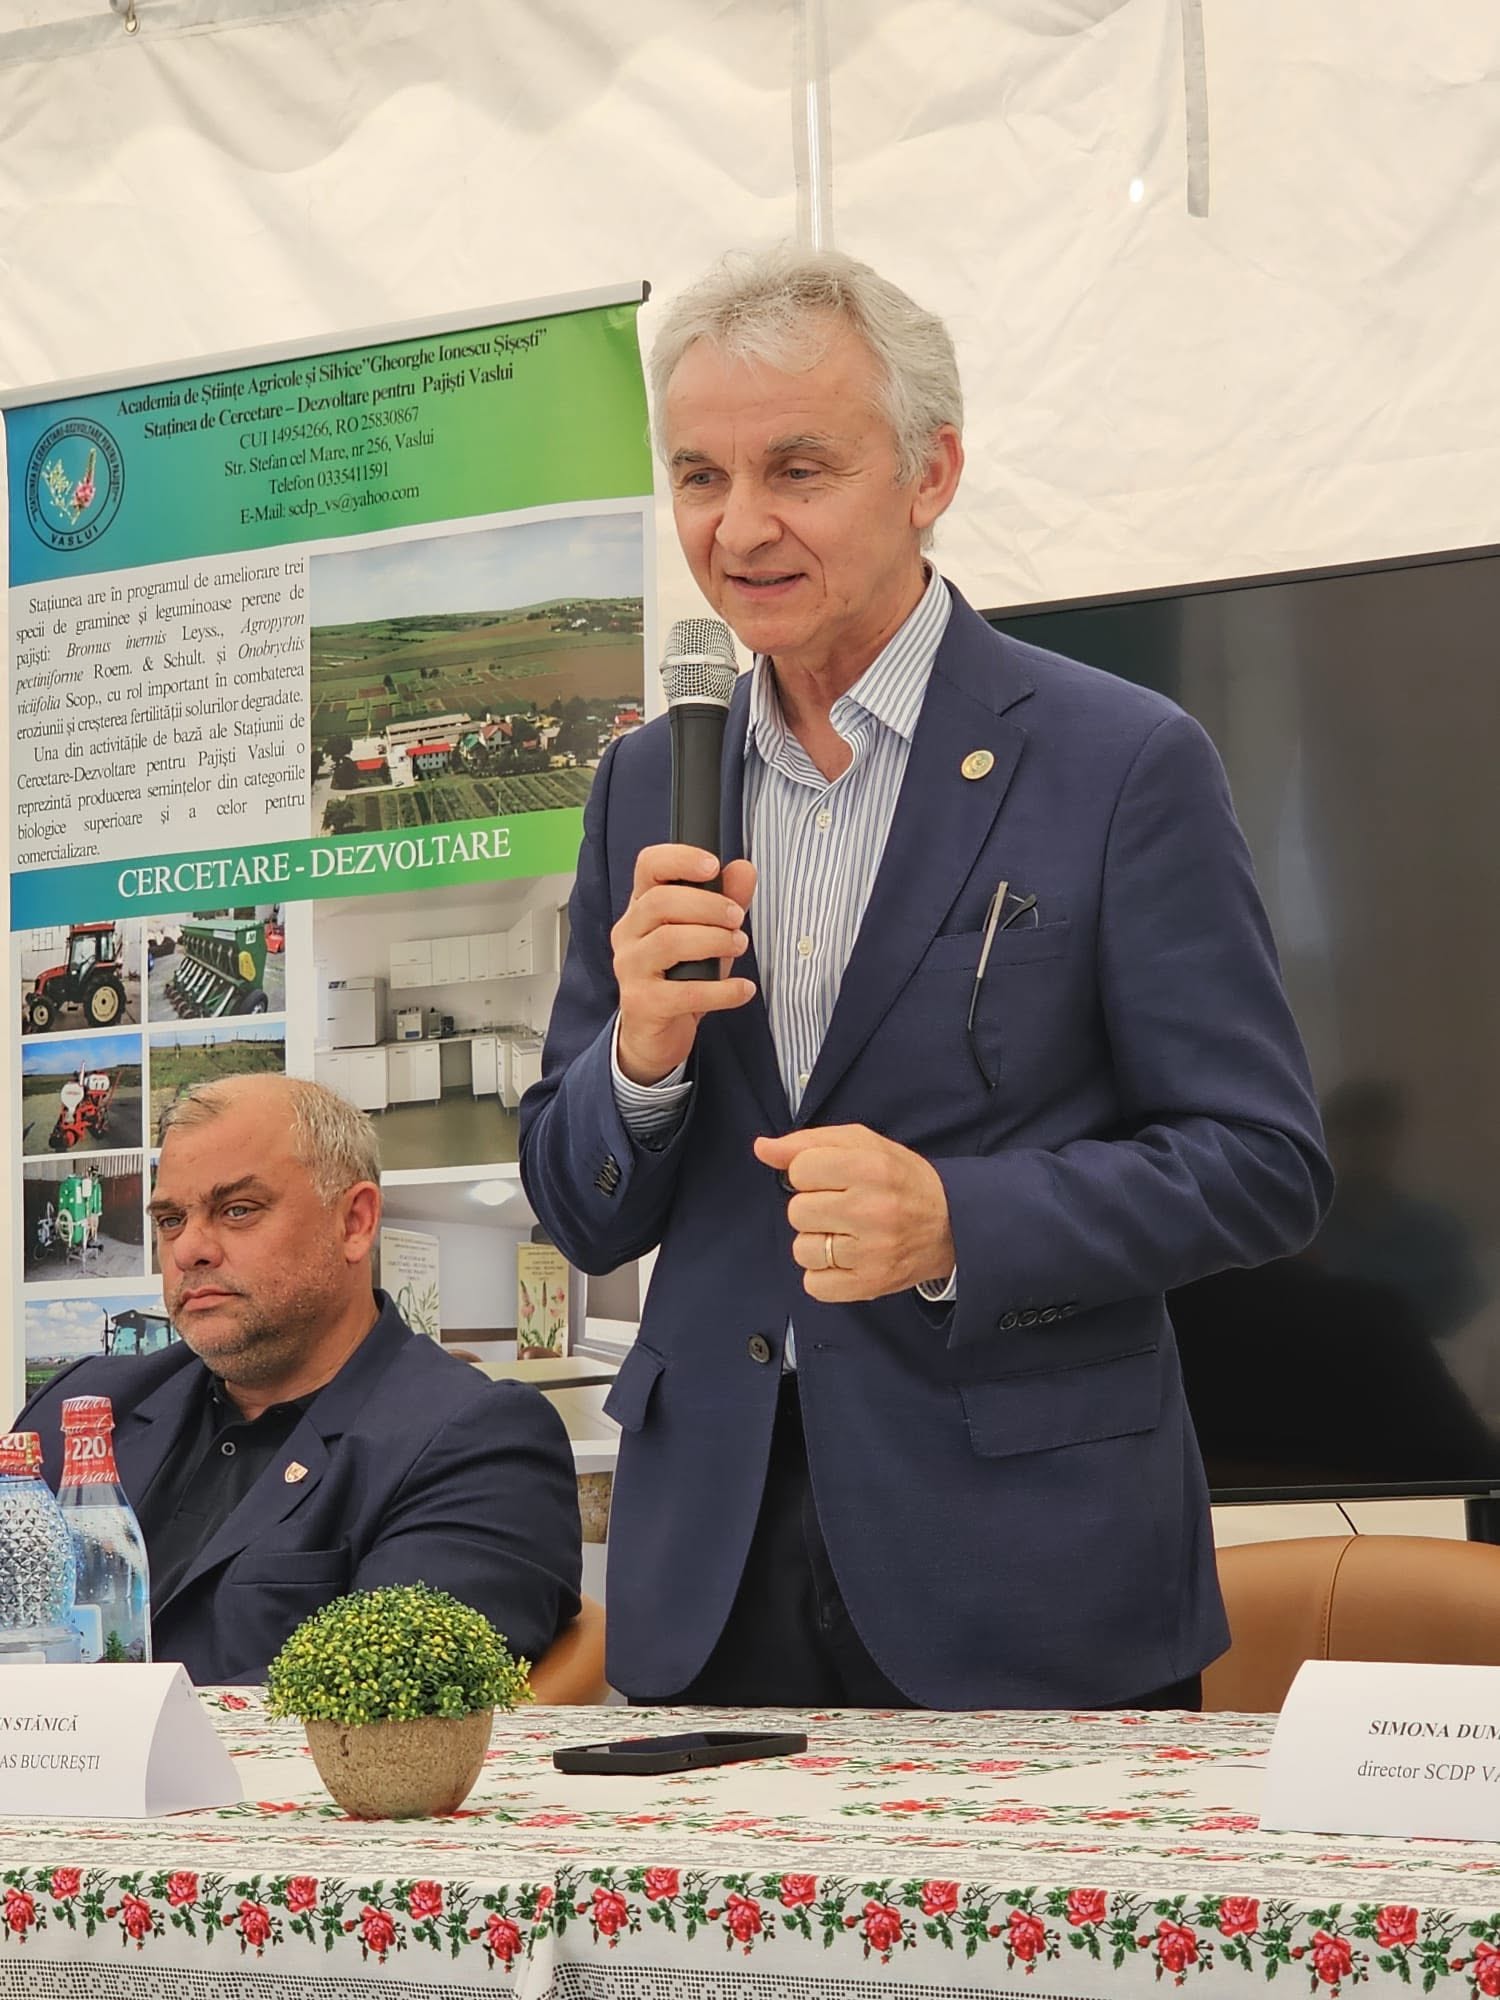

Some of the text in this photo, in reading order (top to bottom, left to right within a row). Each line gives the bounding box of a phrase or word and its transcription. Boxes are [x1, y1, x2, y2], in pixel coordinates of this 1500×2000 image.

[117, 391, 180, 416] Academia
[184, 388, 198, 405] de
[202, 382, 244, 405] Științe
[248, 372, 301, 396] Agricole
[306, 372, 316, 388] și
[440, 342, 490, 362] Ionescu
[144, 418, 197, 439] Staținea
[200, 414, 215, 429] de
[220, 405, 282, 426] Cercetare
[298, 389, 369, 414] Dezvoltare
[373, 382, 415, 405] pentru
[423, 370, 464, 394] Pajiști
[470, 362, 513, 384] Vaslui
[225, 428, 434, 476] Str. Stefan cel Mare, nr 256, Vaslui
[240, 406, 419, 450] CUI 14954266, RO 25830867
[269, 462, 388, 494] Telefon 0335411591
[240, 485, 420, 524] E-Mail: scdp_vs@yahoo.com
[51, 524, 98, 546] VASLUI
[29, 558, 304, 614] Stațiunea are în programul de ameliorare trei
[16, 584, 304, 643] specii de graminee și leguminoase perene de
[16, 613, 304, 670] pajiști: Bromus inermis Leyss., Agropyron
[16, 637, 304, 694] pectiniforme Roem. & Schult. și Onobrychis
[17, 662, 304, 716] viciifolia Scop., cu rol important în combaterea
[16, 690, 304, 740] eroziunii și creșterea fertilității solurilor degradate.
[34, 712, 304, 762] Una din activitățile de bază ale Stațiunii de
[17, 740, 304, 790] Cercetare-Dezvoltare pentru Pajiști Vaslui o
[17, 765, 305, 818] reprezintă producerea semințelor din categoriile
[18, 793, 305, 840] biologice superioare și a celor pentru
[17, 842, 100, 866] comercializare.
[118, 852, 290, 898] CERCETARE
[311, 828, 512, 878] DEZVOLTARE
[72, 1436, 107, 1460] 220
[14, 1714, 79, 1732] STĂNICĂ
[1368, 1720, 1449, 1738] SIMONA
[21, 1754, 100, 1772] BUCUREȘTI
[1357, 1760, 1421, 1779] director
[1424, 1763, 1476, 1781] SCDP
